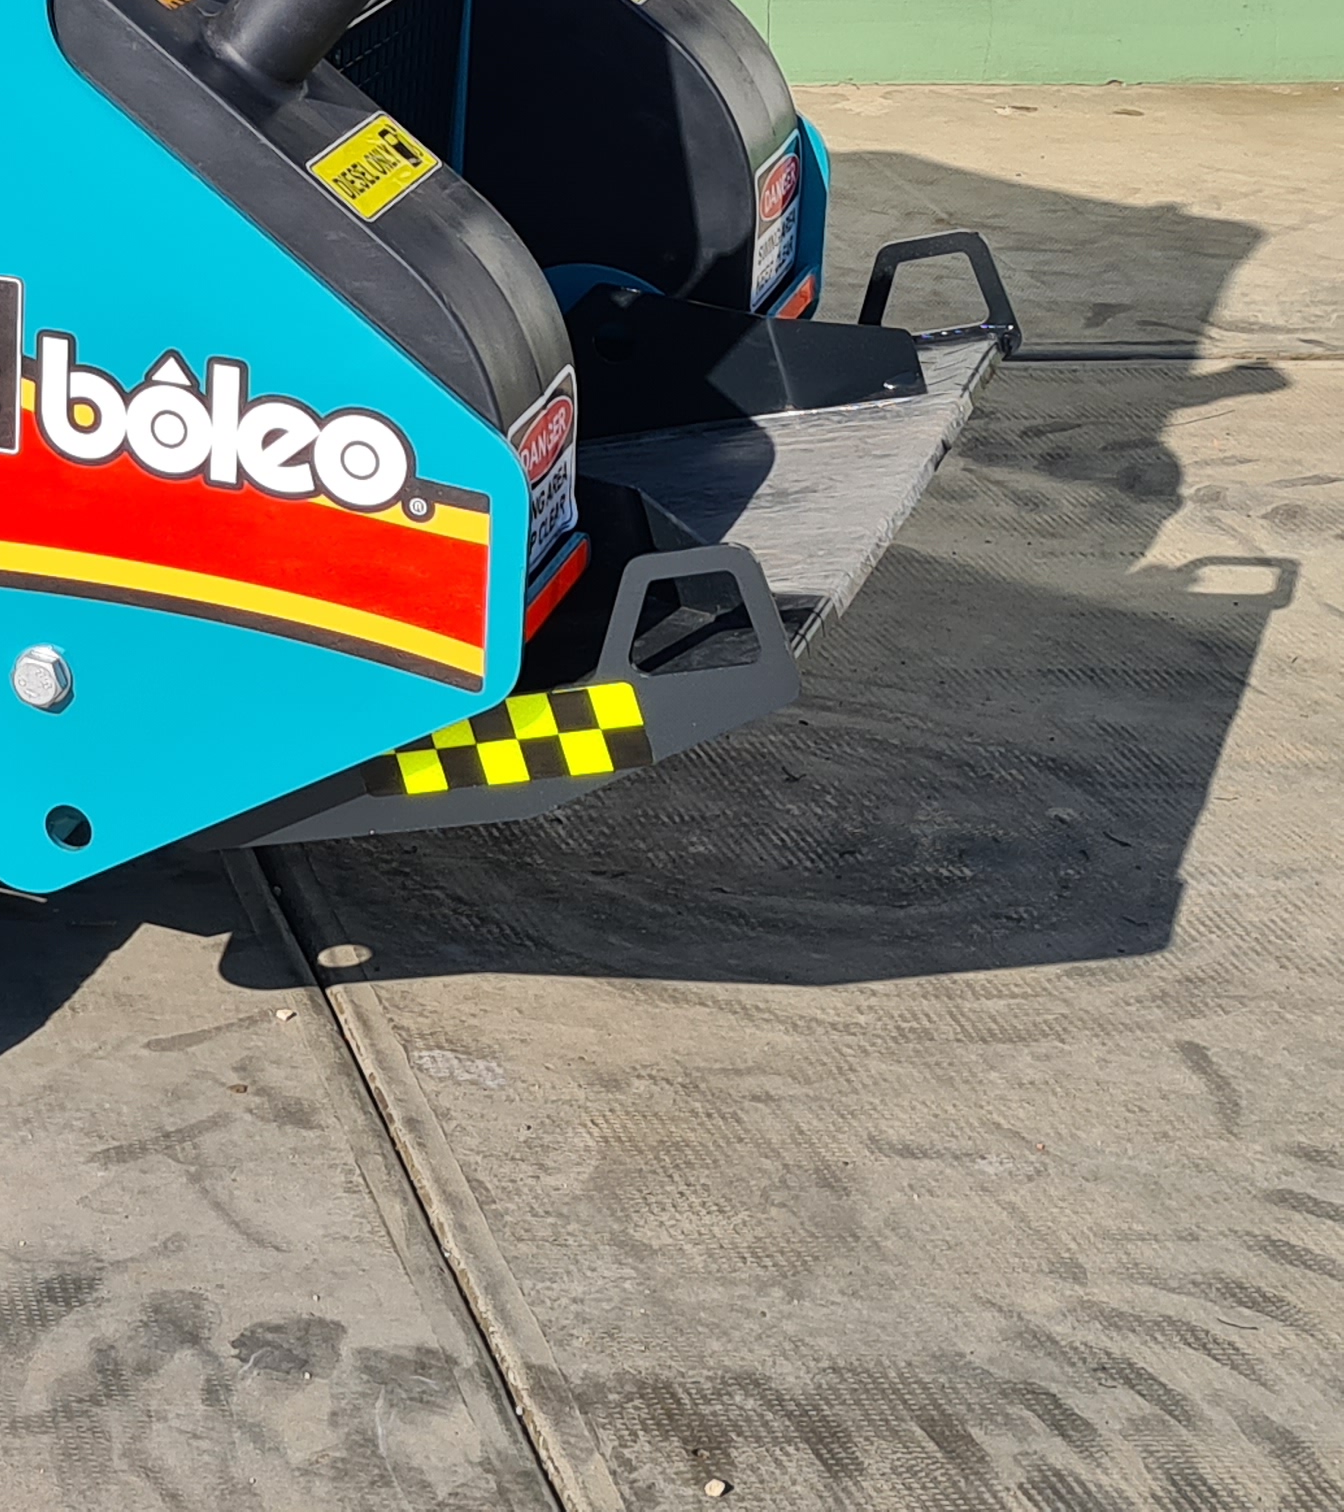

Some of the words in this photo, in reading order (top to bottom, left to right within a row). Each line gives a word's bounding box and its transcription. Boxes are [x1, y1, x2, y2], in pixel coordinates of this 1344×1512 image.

[332, 161, 381, 201] DIESEL
[364, 143, 402, 177] ONLY
[764, 160, 798, 215] DANGER
[521, 406, 568, 471] DANGER
